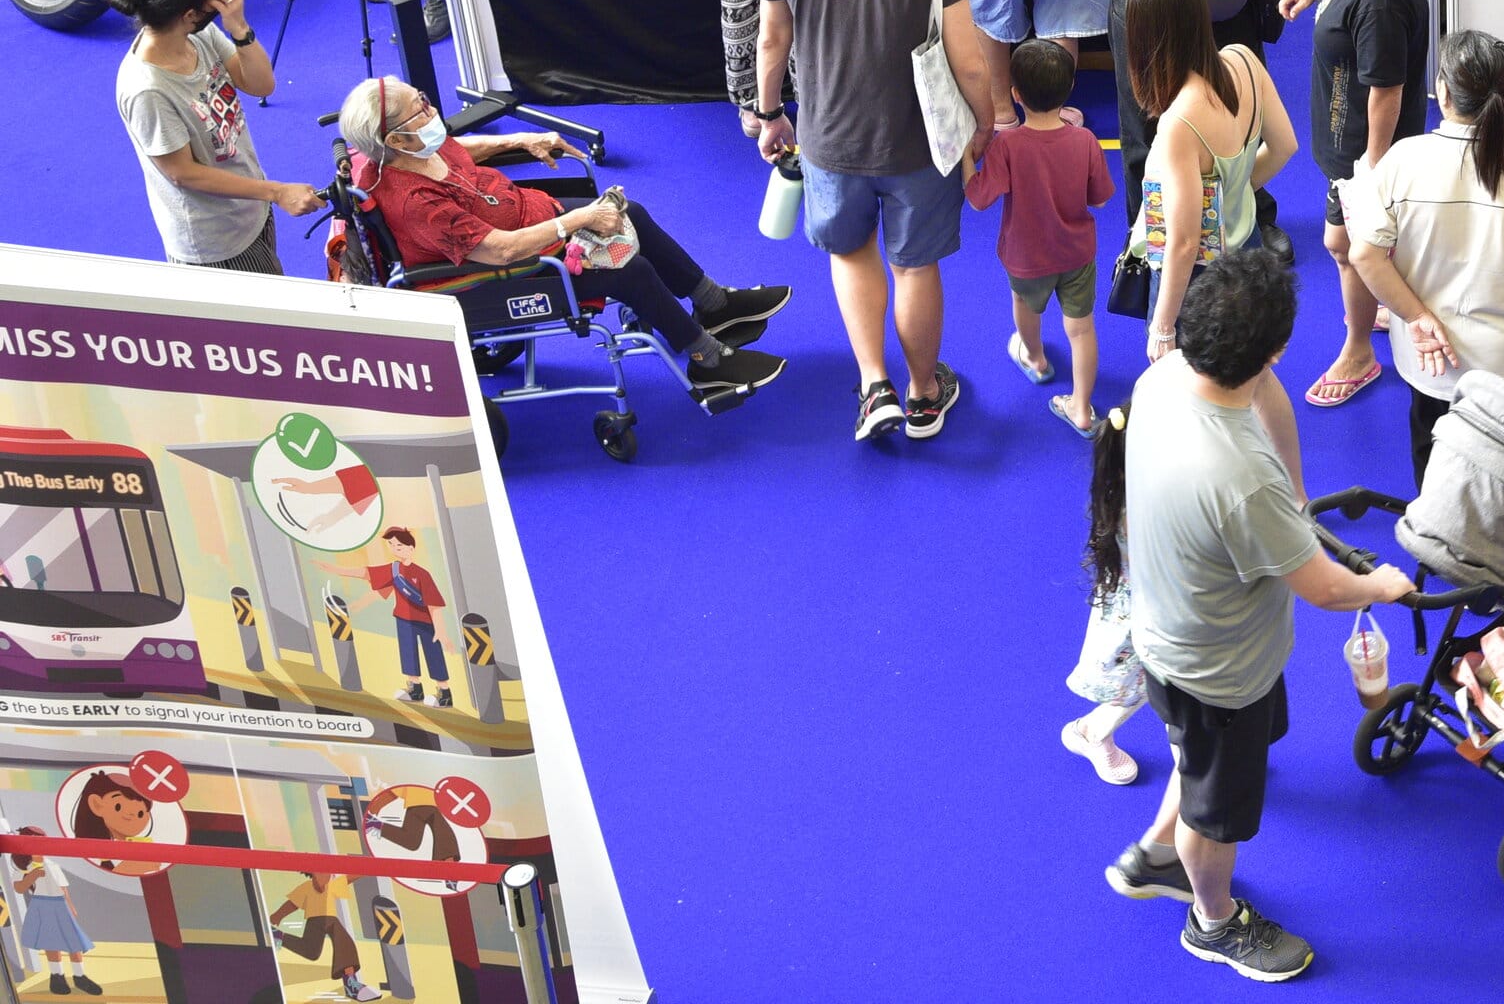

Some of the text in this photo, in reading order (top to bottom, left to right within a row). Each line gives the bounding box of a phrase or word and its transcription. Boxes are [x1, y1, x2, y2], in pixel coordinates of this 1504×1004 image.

[512, 299, 536, 308] LIFE
[520, 305, 546, 315] LINE
[82, 332, 195, 369] YOUR
[204, 343, 282, 376] BUS
[294, 352, 434, 392] AGAIN!
[4, 471, 33, 488] The
[34, 474, 64, 490] Bus
[64, 474, 104, 493] Early
[112, 472, 144, 495] 88
[63, 632, 102, 642] Transit
[12, 702, 37, 713] the
[40, 703, 69, 716] bus
[73, 705, 120, 717] EARLY
[124, 705, 140, 717] to
[145, 704, 190, 720] signal
[193, 710, 225, 724] your
[228, 710, 295, 728] intention
[298, 717, 313, 729] to
[316, 717, 362, 733] board
